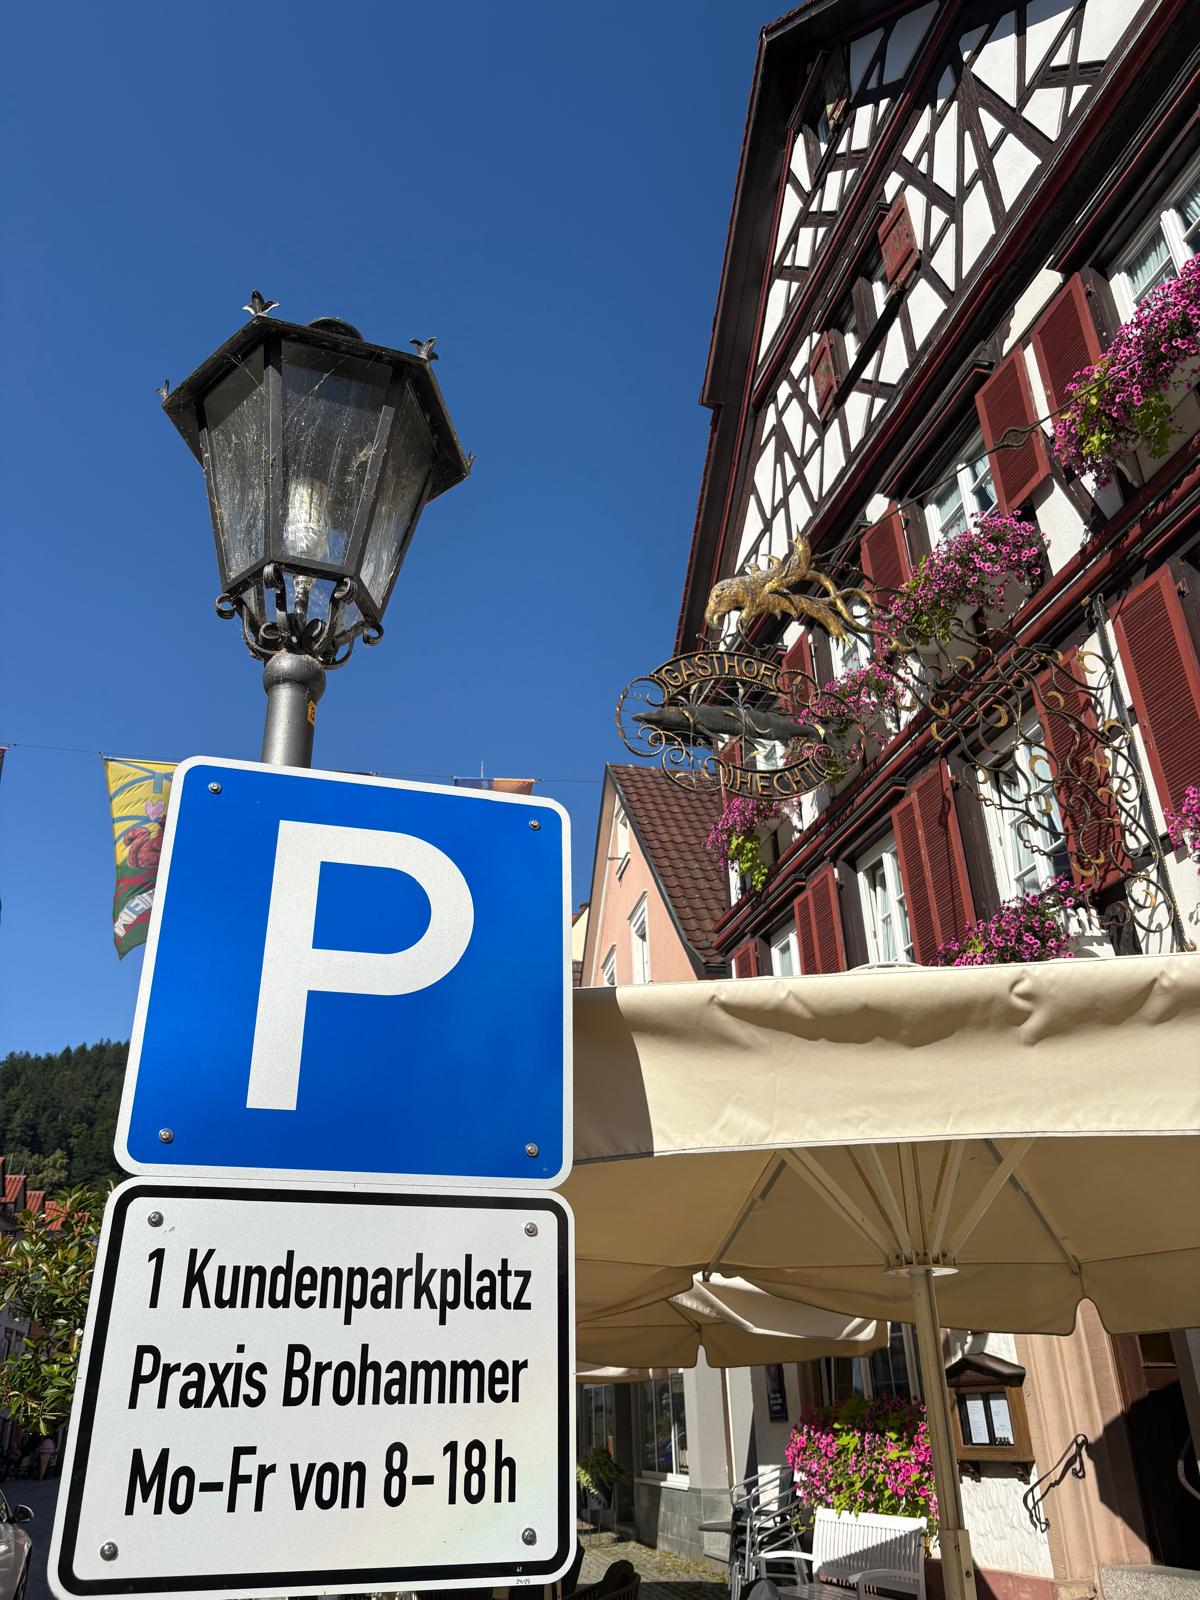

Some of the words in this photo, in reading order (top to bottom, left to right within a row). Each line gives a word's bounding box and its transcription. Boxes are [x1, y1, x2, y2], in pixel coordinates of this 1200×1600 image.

[661, 653, 777, 686] GASTHOF
[735, 763, 820, 795] HECHT
[246, 819, 475, 1111] P
[147, 1247, 166, 1309] 1
[182, 1248, 532, 1326] Kundenparkplatz
[127, 1343, 268, 1410] Praxis
[282, 1343, 529, 1407] Brohammer
[289, 1461, 367, 1511] von
